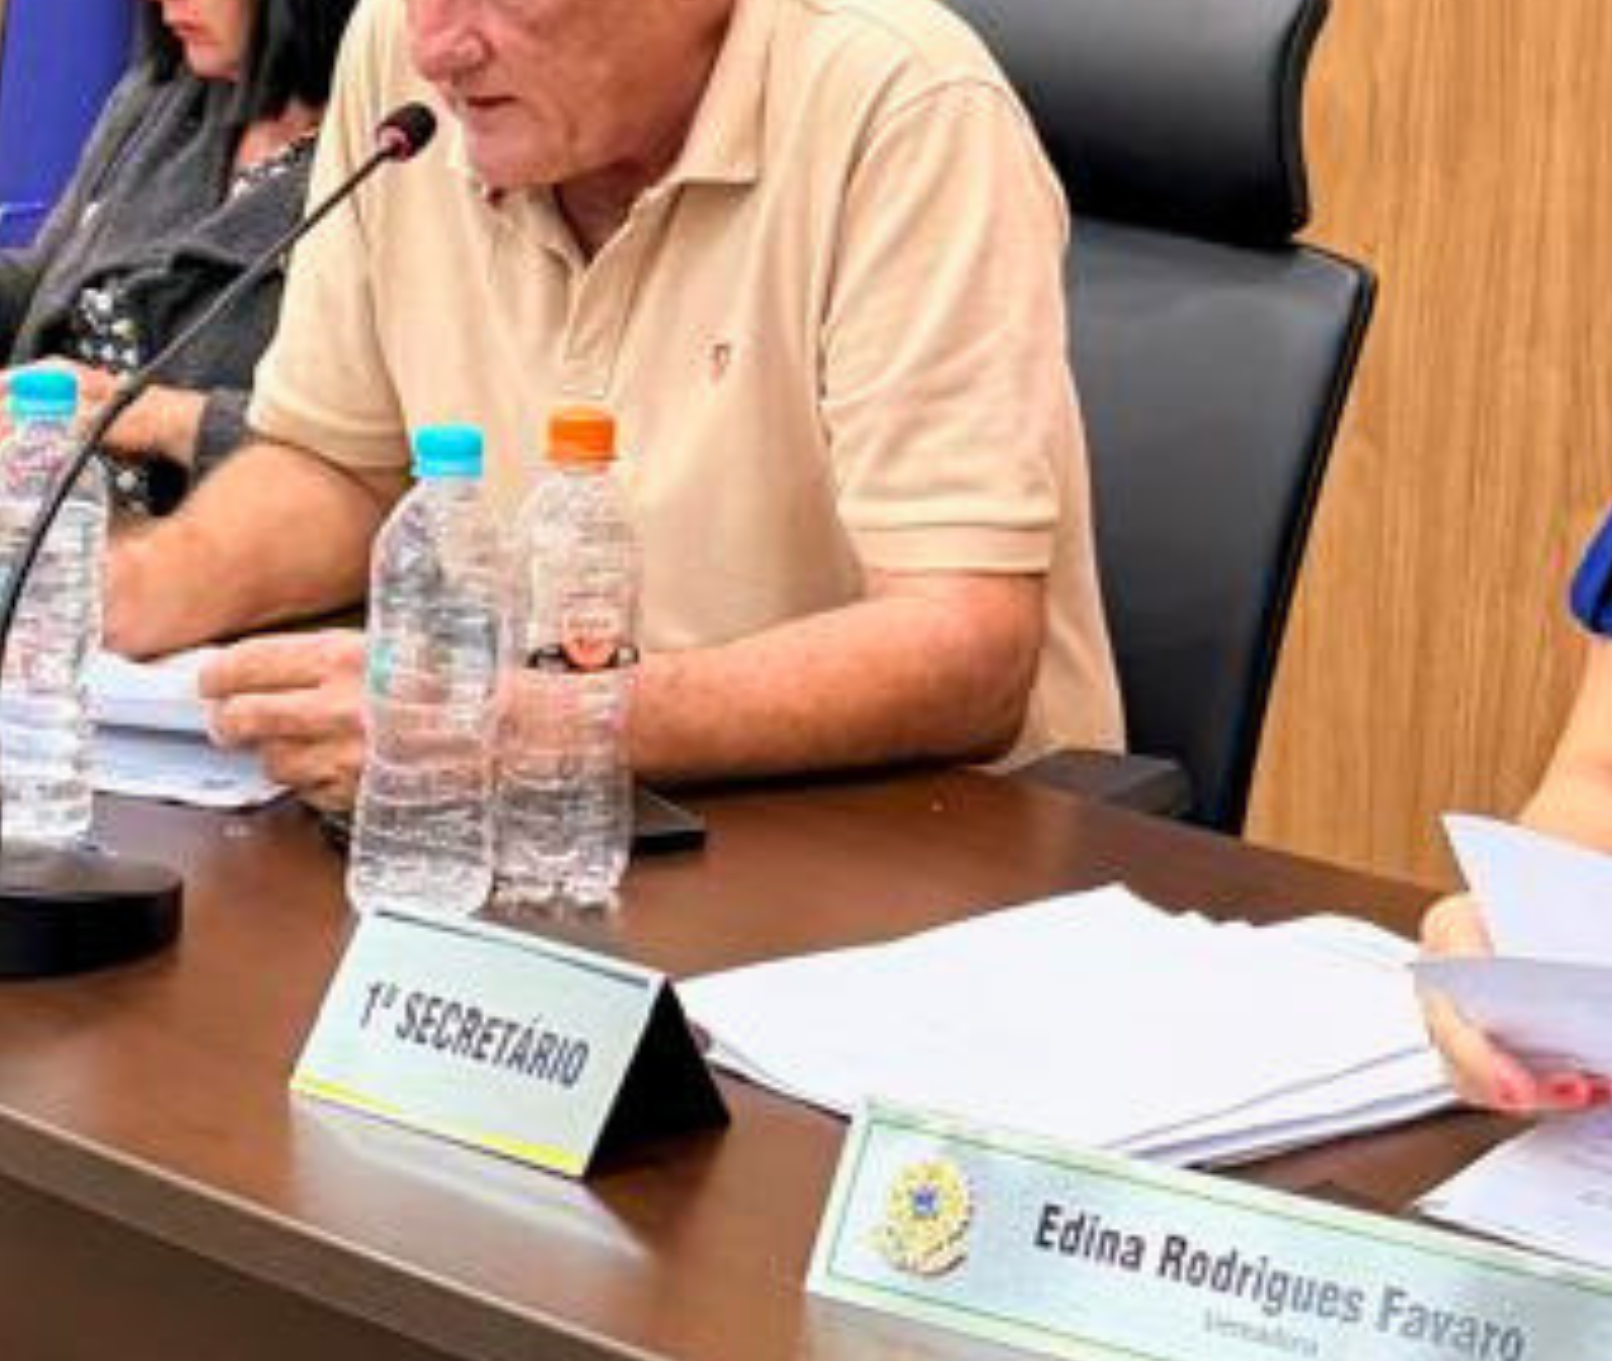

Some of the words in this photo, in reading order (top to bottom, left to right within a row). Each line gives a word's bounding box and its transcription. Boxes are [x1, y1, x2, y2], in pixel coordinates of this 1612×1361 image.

[395, 990, 590, 1088] SECRETÁRIO
[1034, 1203, 1144, 1271] Edina
[1156, 1234, 1365, 1324] Rodrigues
[1376, 1286, 1525, 1361] Favaro
